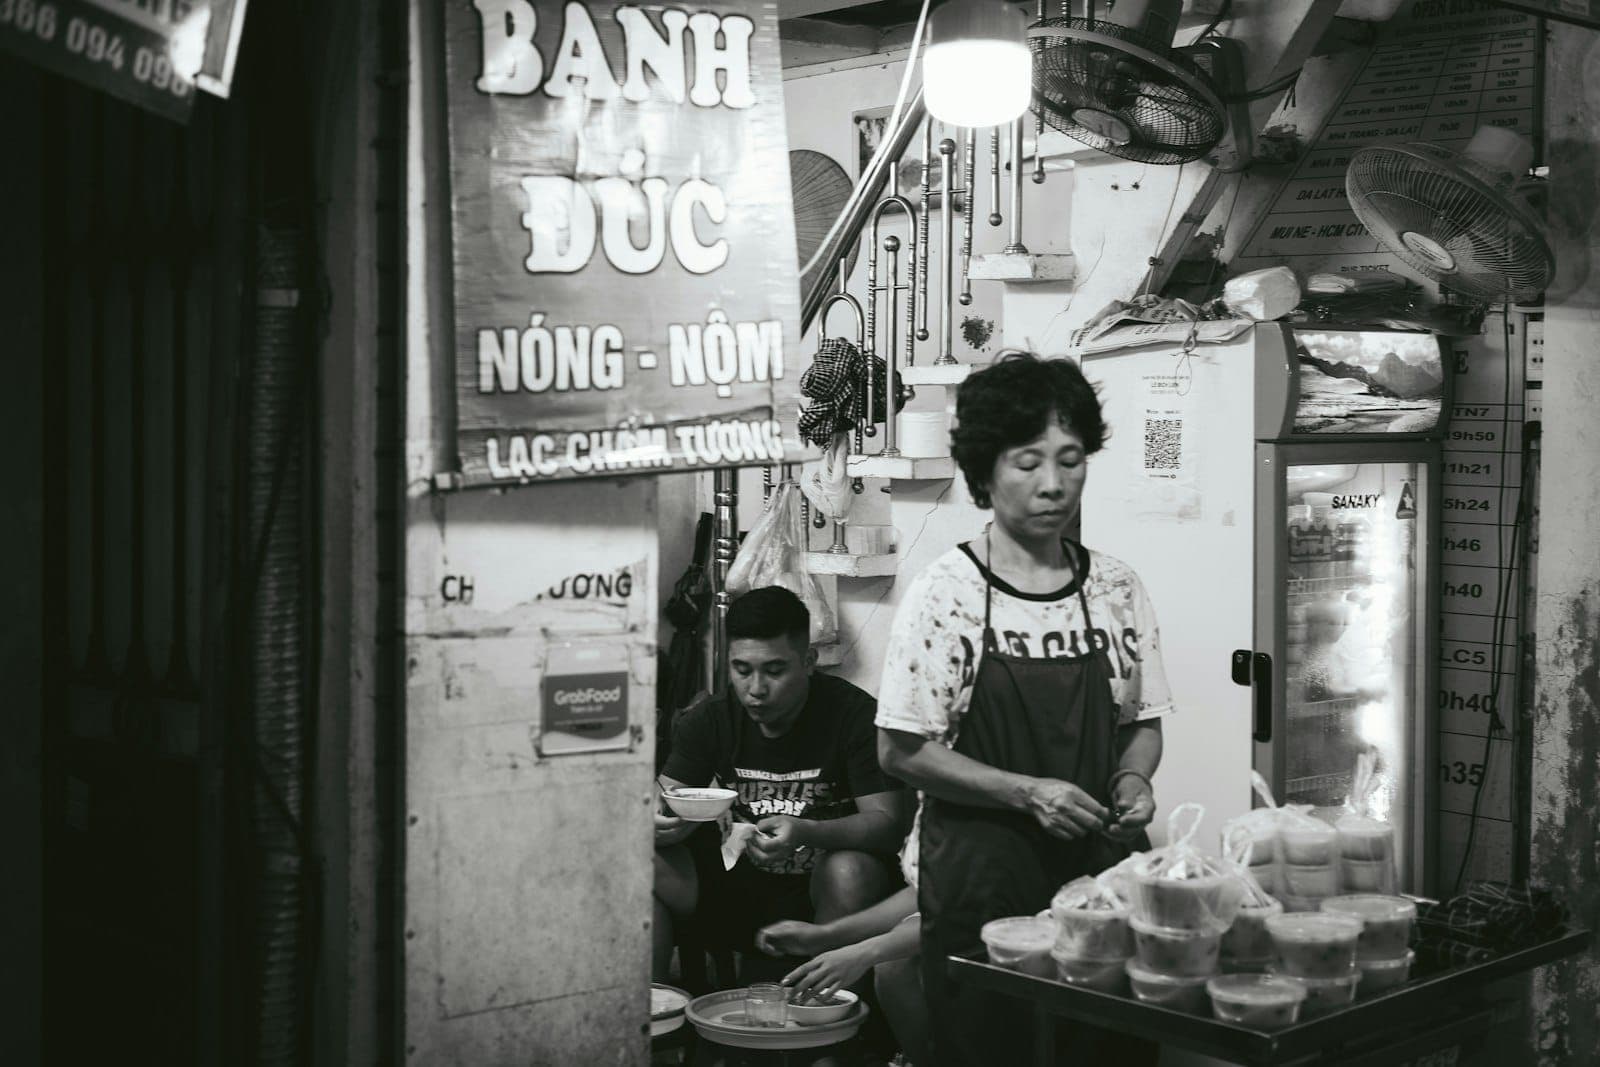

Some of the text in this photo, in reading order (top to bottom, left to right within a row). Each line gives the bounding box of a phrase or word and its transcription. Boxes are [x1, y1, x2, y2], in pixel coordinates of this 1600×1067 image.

[65, 17, 127, 71] 094
[1296, 189, 1313, 201] DA
[1313, 187, 1336, 200] LAT
[1270, 226, 1294, 240] MUI
[1292, 225, 1313, 239] NE
[1317, 224, 1346, 238] HCM
[478, 312, 625, 395] NÓNG
[667, 308, 785, 399] NỘM
[1331, 494, 1380, 509] SANAKY
[553, 685, 621, 706] GrabFood
